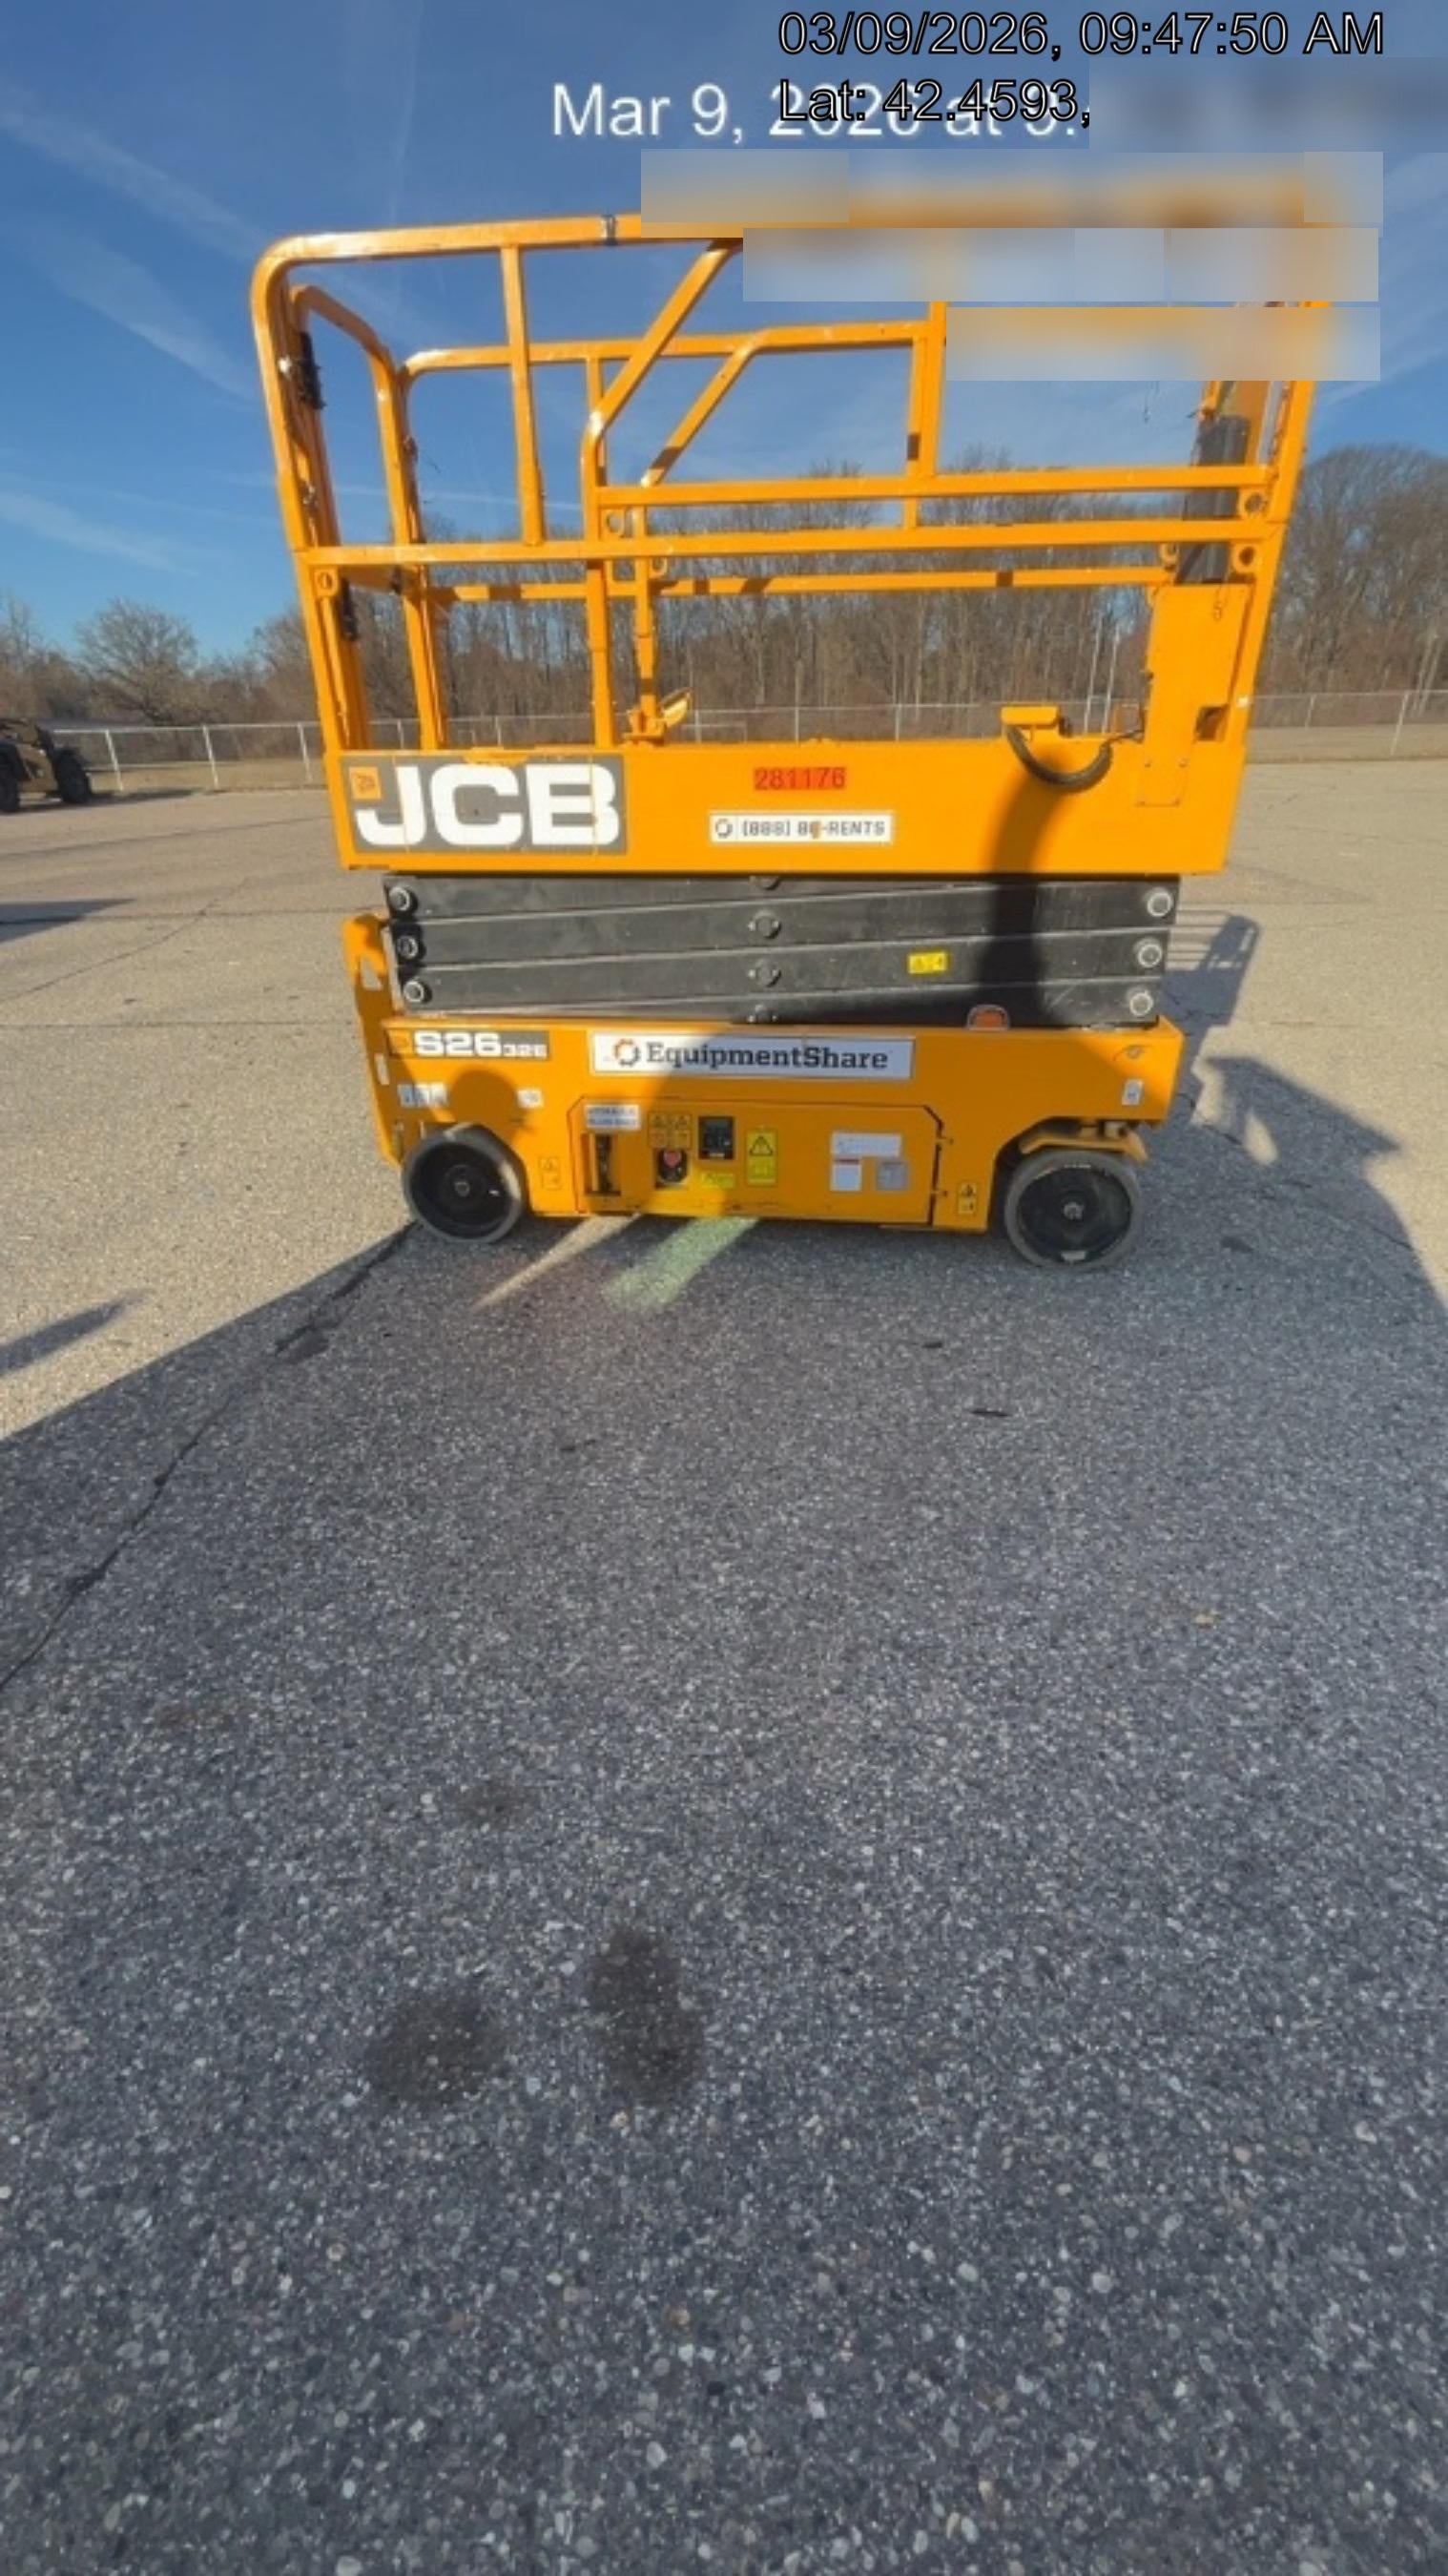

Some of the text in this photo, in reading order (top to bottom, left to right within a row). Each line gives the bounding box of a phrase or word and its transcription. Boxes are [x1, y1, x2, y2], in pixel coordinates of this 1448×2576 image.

[754, 767, 846, 791] 281176
[355, 762, 620, 847] JCB
[646, 1040, 889, 1070] EquipmentShare
